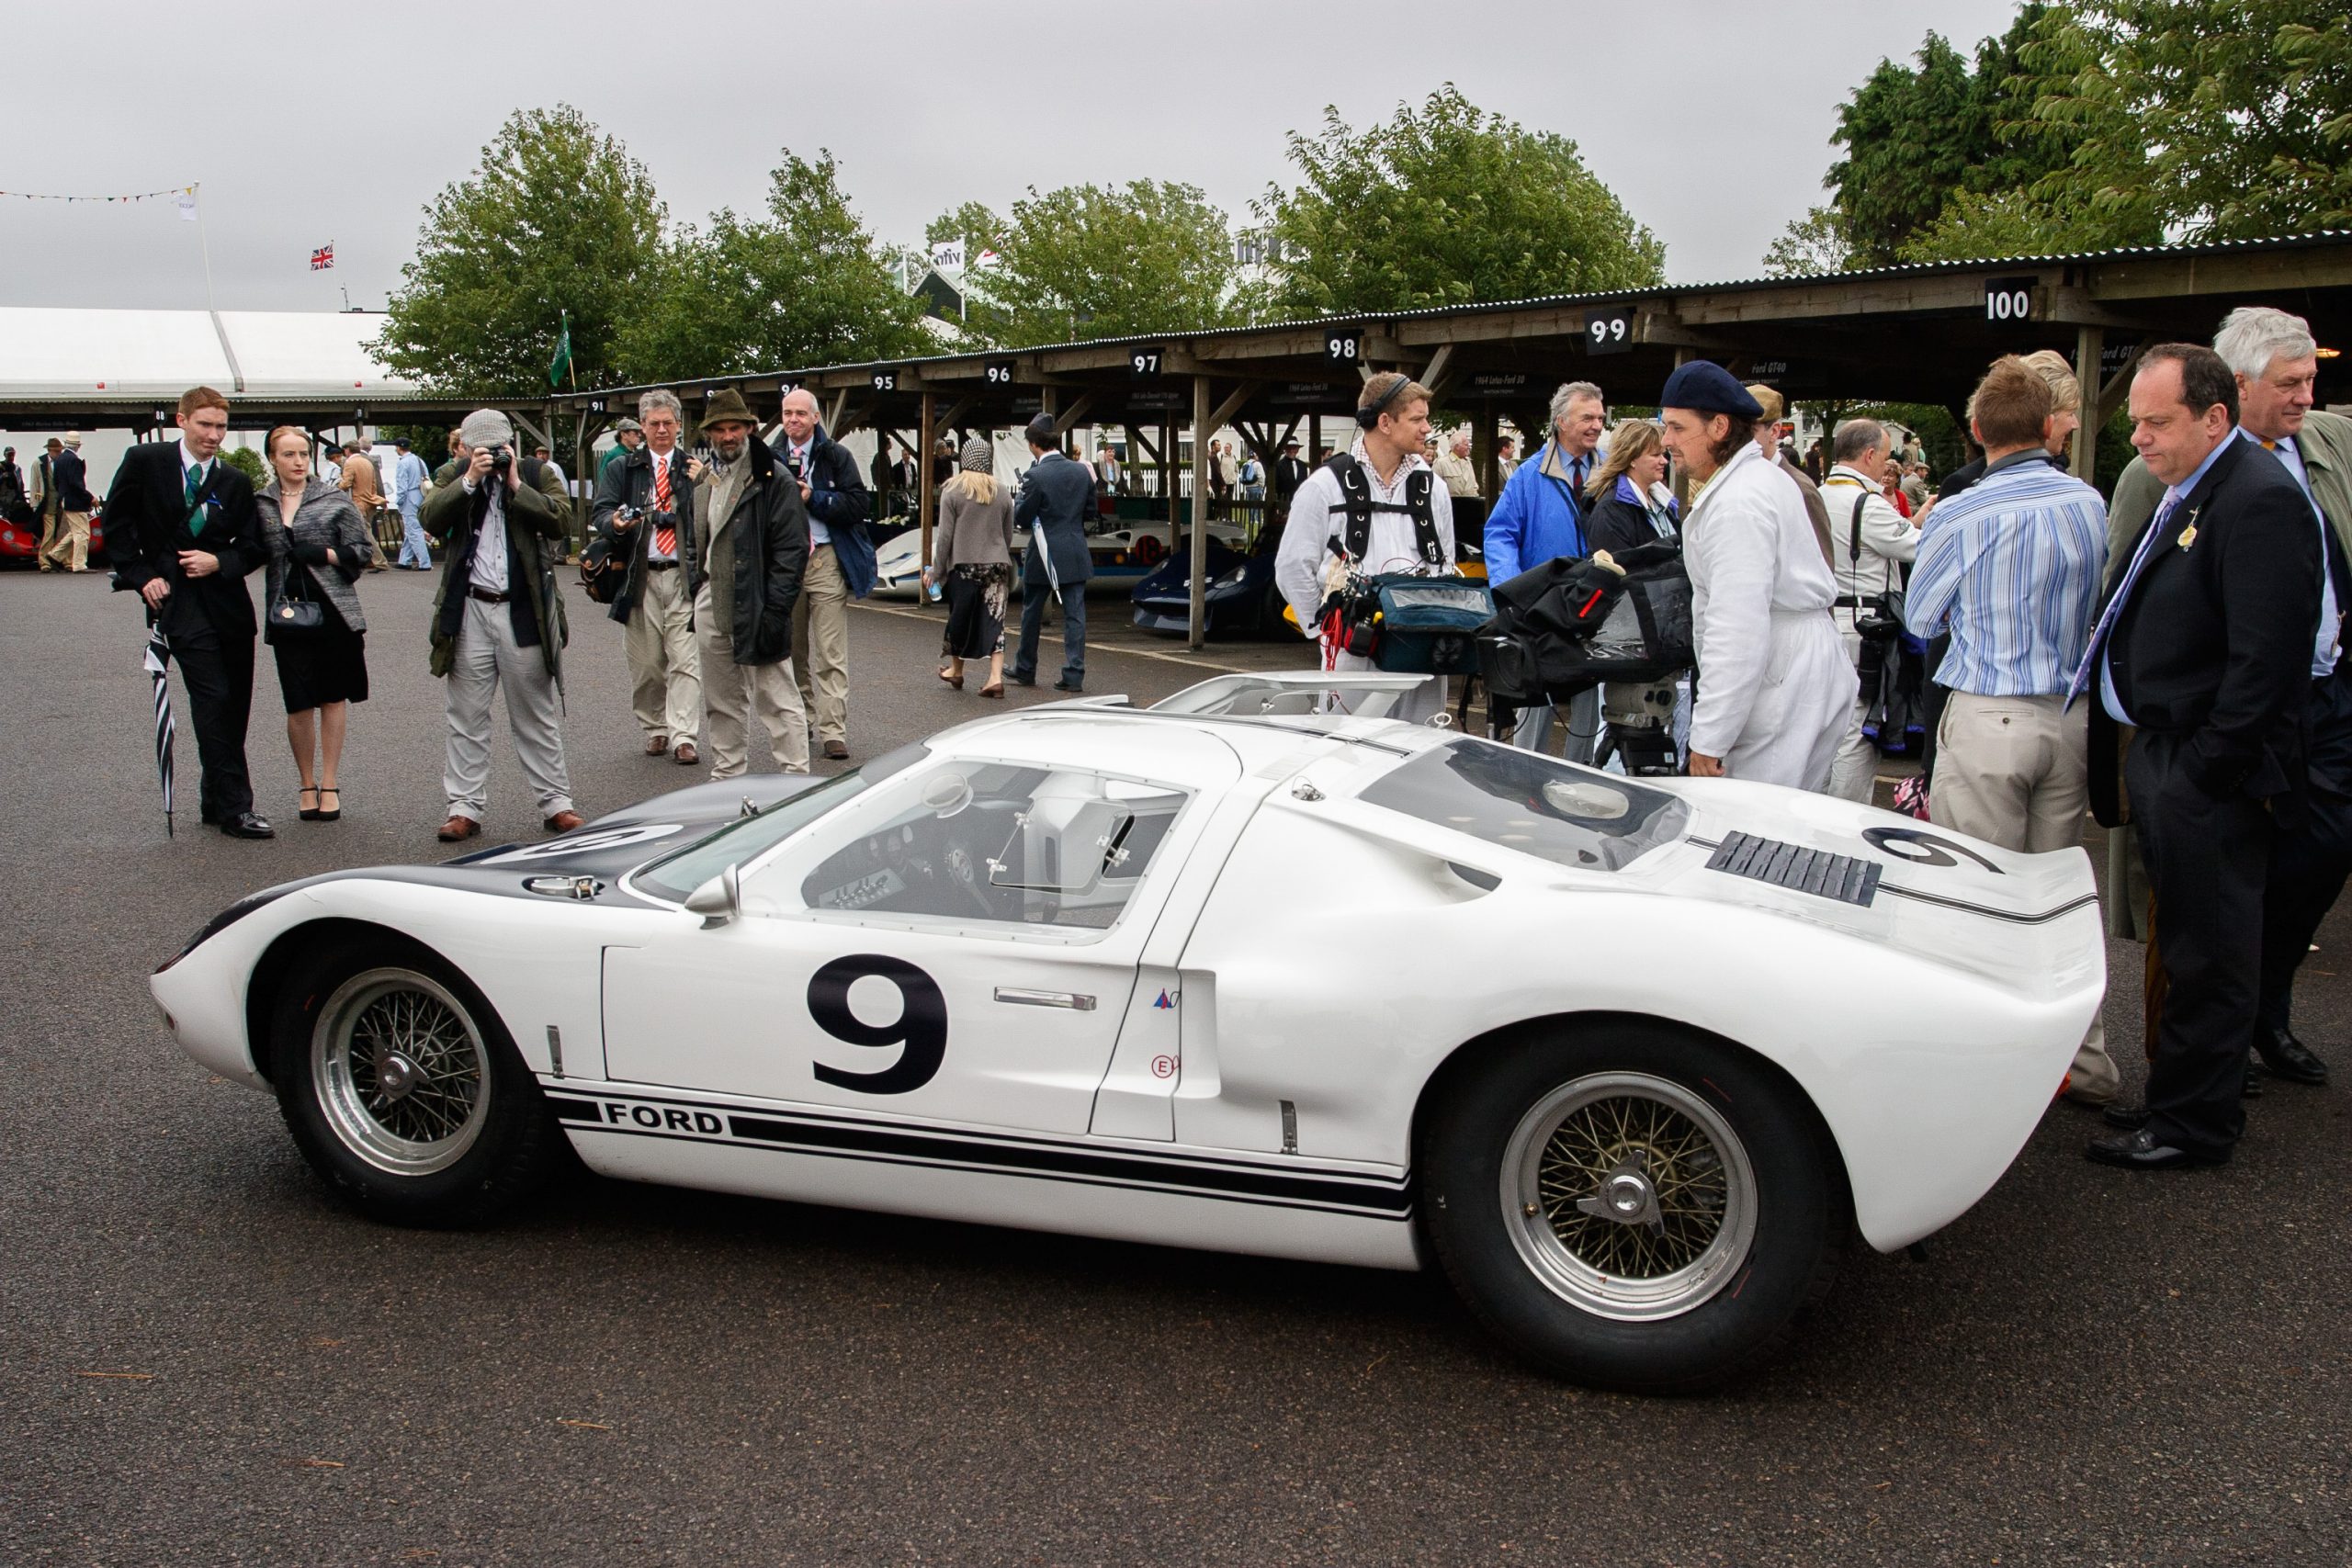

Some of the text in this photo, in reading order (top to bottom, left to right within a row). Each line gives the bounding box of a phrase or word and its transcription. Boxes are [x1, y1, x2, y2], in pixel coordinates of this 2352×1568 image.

[1987, 291, 2029, 320] 100
[1590, 319, 1625, 344] 99
[1329, 338, 1356, 358] 98
[1135, 355, 1158, 373] 97
[1767, 362, 1787, 374] GT40
[874, 376, 893, 389] 95
[988, 367, 1010, 382] 96
[592, 401, 604, 412] 91
[807, 953, 948, 1095] 9
[604, 1102, 724, 1135] FORD
